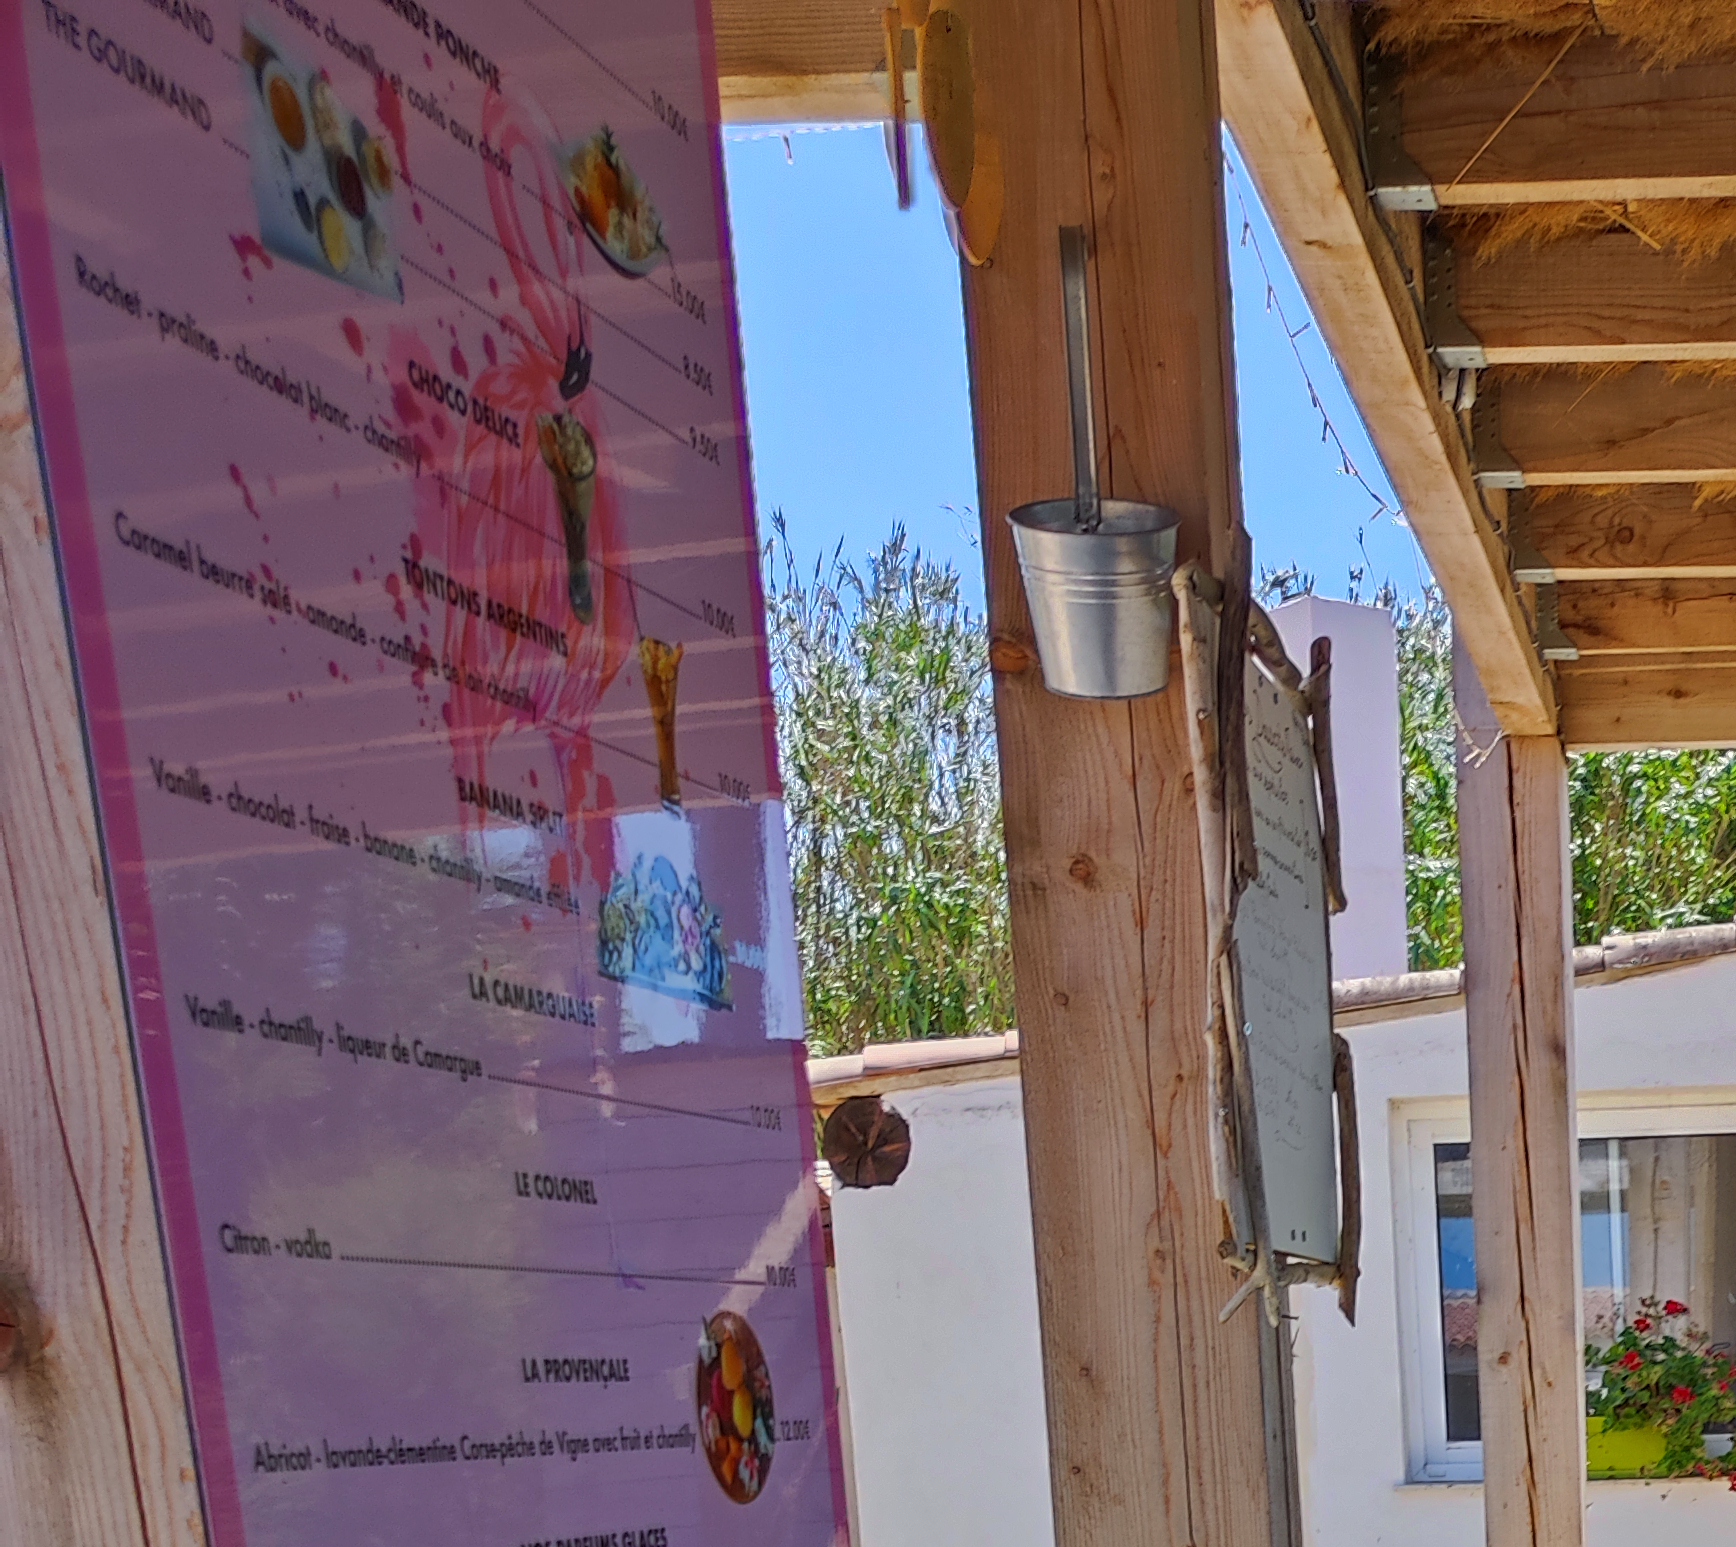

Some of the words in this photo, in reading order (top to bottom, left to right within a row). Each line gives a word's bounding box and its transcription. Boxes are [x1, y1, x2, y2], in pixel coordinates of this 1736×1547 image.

[41, 0, 82, 51] THE
[87, 28, 213, 133] GOURMAND
[433, 19, 503, 95] PONCHE
[450, 119, 475, 151] aux
[157, 309, 220, 362] praline
[234, 344, 304, 407] chocolat
[306, 380, 351, 433] blanc
[408, 359, 468, 418] CHOCO
[471, 397, 521, 450] DÉLICE
[114, 511, 194, 574] Caramel
[196, 545, 255, 600] beurre
[259, 578, 292, 615] salé
[306, 604, 368, 647] amande
[401, 557, 482, 618] TONTONS
[486, 598, 569, 658] ARGENTINS
[148, 757, 213, 804] Vanille
[226, 781, 297, 831] chocolat
[307, 803, 351, 847] fraise
[361, 820, 418, 867] banane
[429, 845, 483, 894] chantilly
[456, 777, 527, 823] BANANA
[529, 800, 565, 838] SPLIT
[184, 993, 246, 1035] Vanille
[258, 1007, 325, 1057] chantilly
[336, 1020, 388, 1064] liqueur
[391, 1032, 411, 1065] de
[413, 1038, 484, 1083] Camargue
[468, 972, 491, 1005] LA
[492, 979, 597, 1028] CAMARGUAISE
[514, 1171, 532, 1198] LE
[533, 1173, 598, 1205] COLONEL
[219, 1223, 271, 1256] Citron
[284, 1227, 332, 1260] vodka
[521, 1358, 542, 1384] LA
[543, 1358, 631, 1390] PROVENÇALE
[253, 1441, 313, 1474] Abricot
[538, 1429, 555, 1457] de
[555, 1430, 590, 1463] Vigne
[592, 1437, 619, 1454] avec
[619, 1425, 642, 1451] fruit
[644, 1430, 654, 1450] et
[656, 1423, 697, 1455] chantilly
